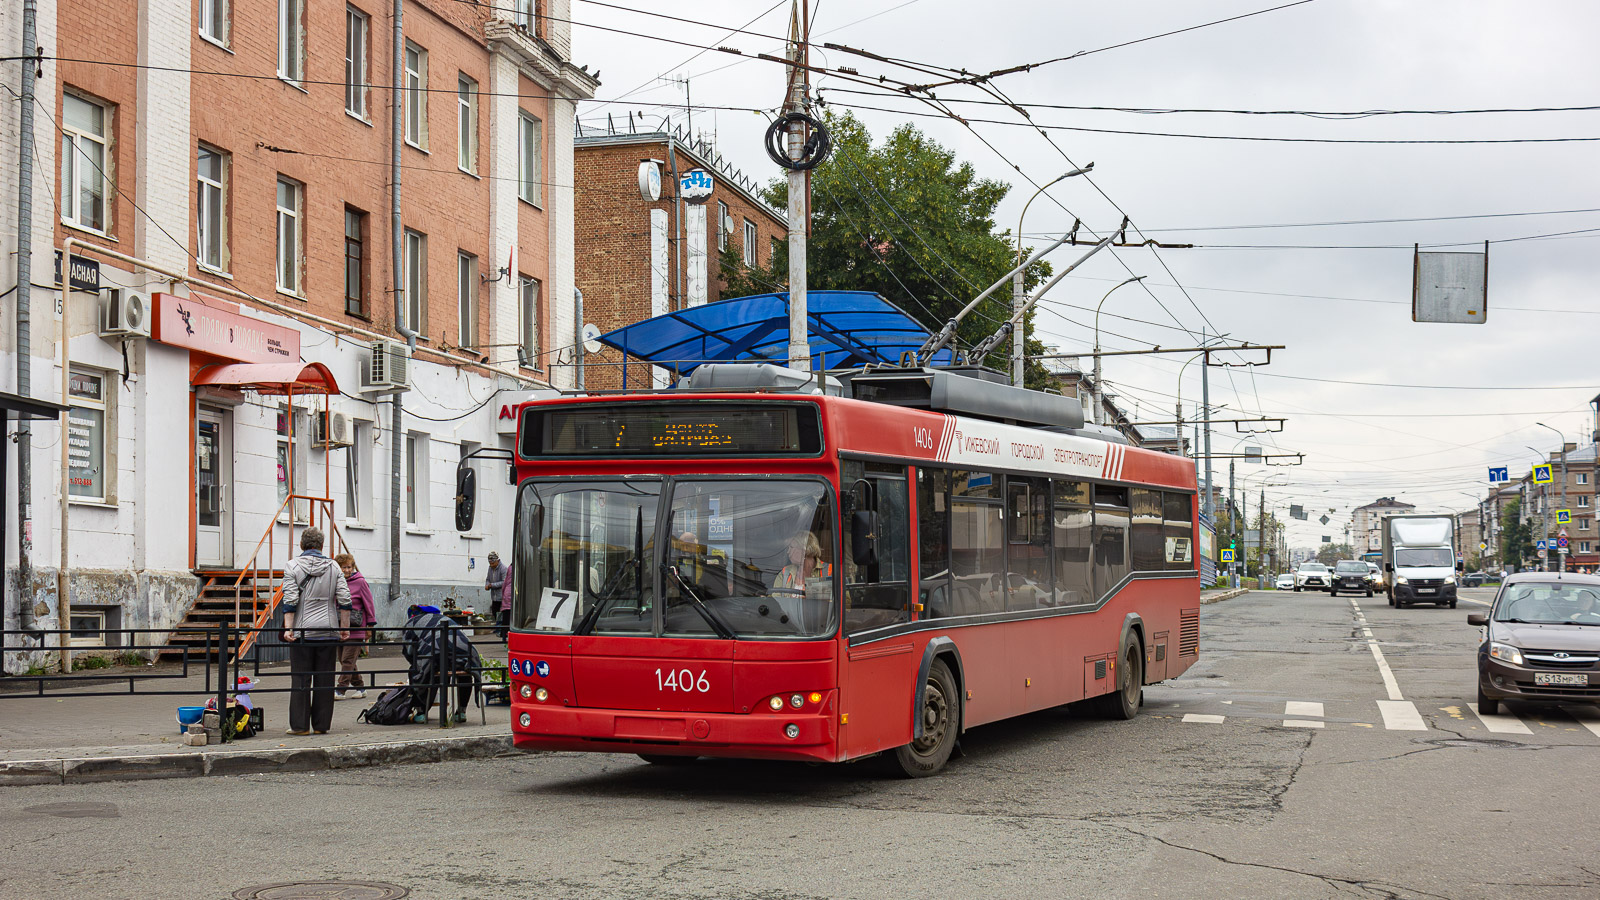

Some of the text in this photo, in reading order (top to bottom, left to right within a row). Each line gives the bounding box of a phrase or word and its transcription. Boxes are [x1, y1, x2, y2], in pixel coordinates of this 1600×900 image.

[61, 260, 96, 285] АСНАЯ
[201, 316, 228, 344] ПРЯДКИ
[234, 325, 264, 356] ПОРЯДКЕ
[914, 426, 932, 449] 1406
[965, 435, 1103, 468] ИЖЕВСКИЙ ГОРОДСКОЙ ЭЛЕКТРОТРАНСПОРТ
[550, 591, 570, 618] 7
[655, 668, 710, 693] 1406
